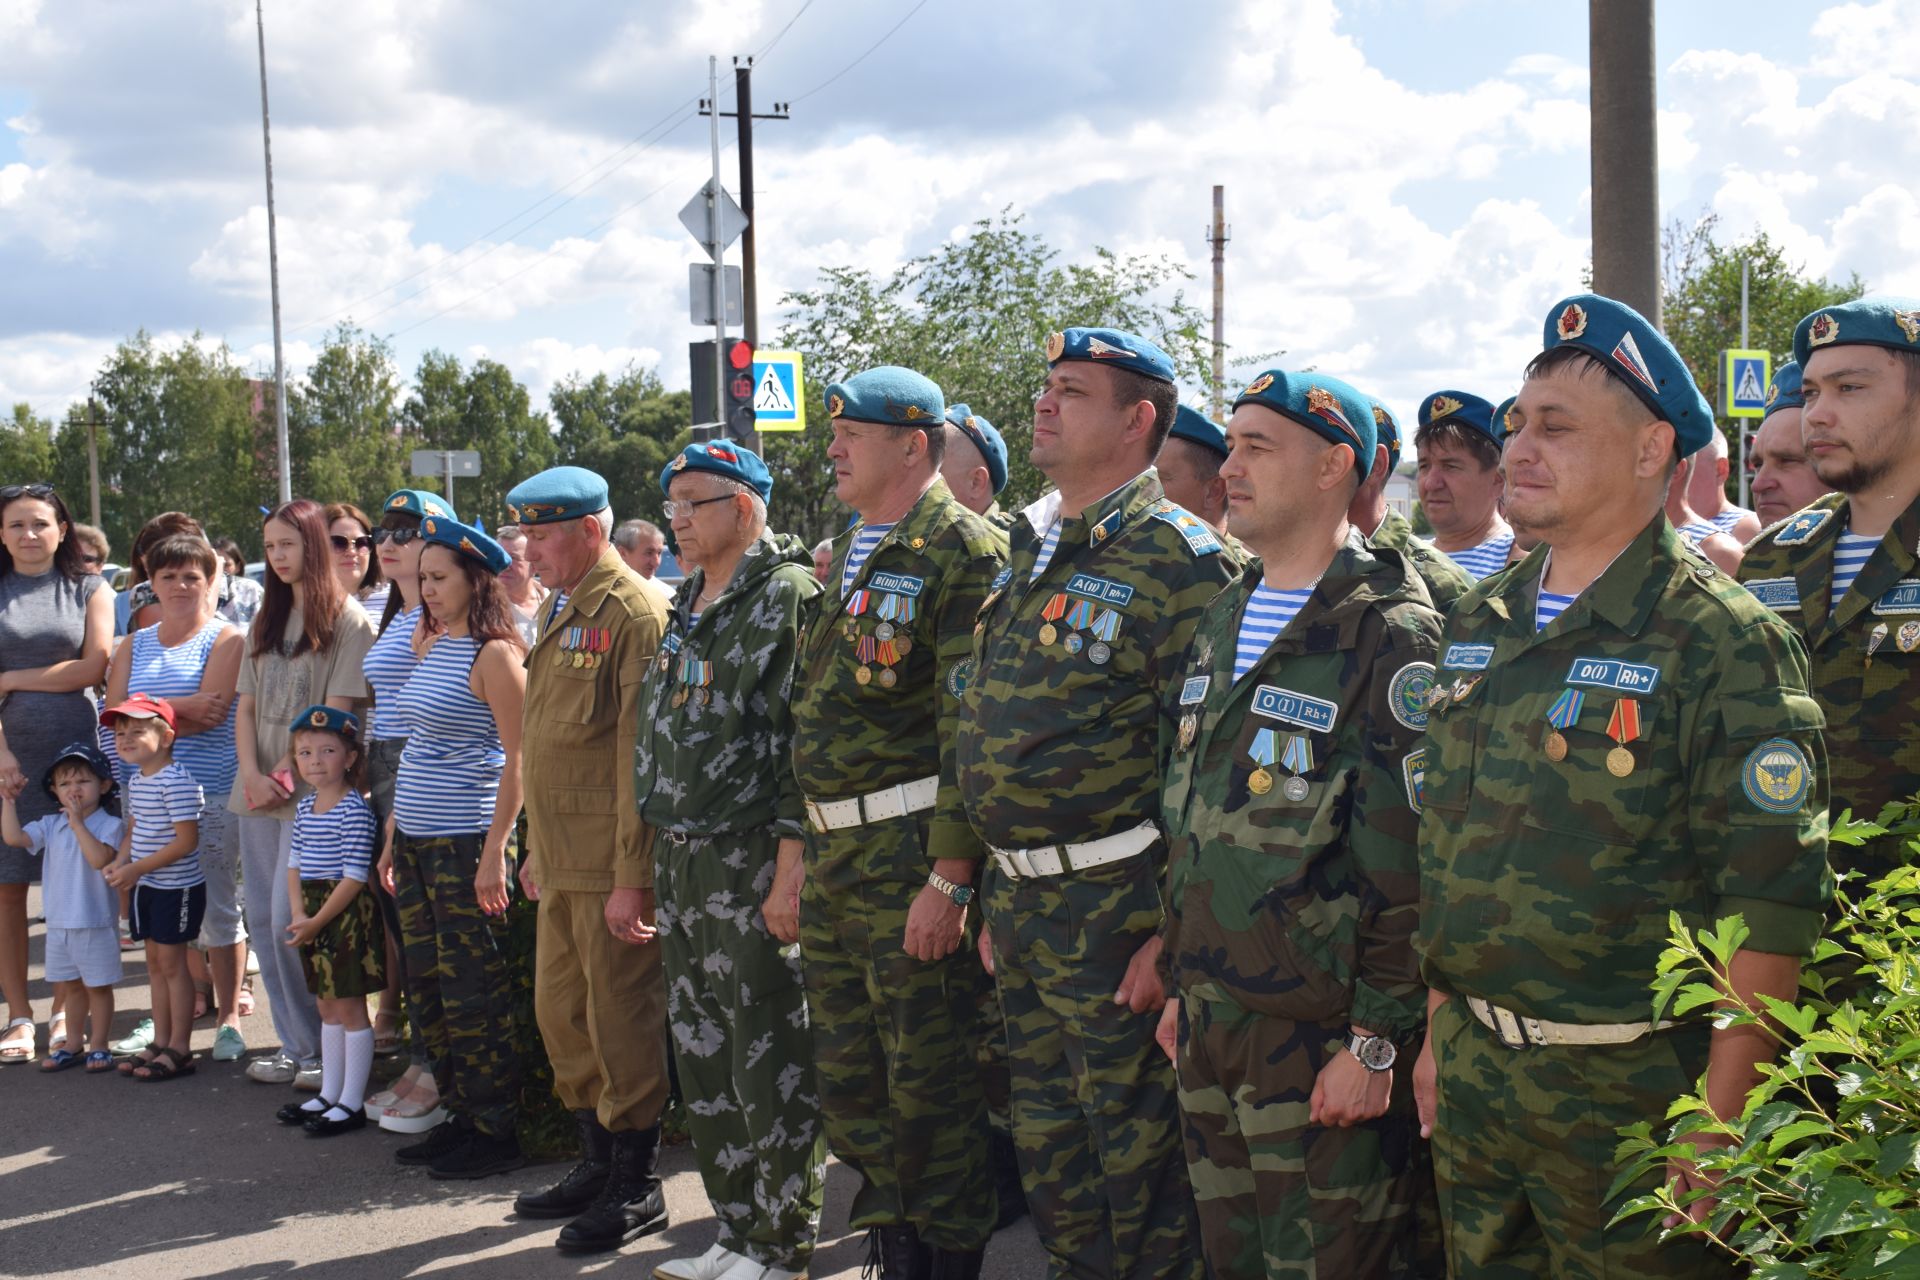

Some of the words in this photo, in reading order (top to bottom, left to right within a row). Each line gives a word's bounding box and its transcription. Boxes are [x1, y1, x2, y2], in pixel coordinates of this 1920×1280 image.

[902, 580, 919, 591] Rh+
[1073, 579, 1101, 593] A(II)
[1108, 589, 1127, 599] Rh+
[1892, 587, 1918, 603] A(II)
[1619, 669, 1649, 685] Rh+
[1303, 706, 1329, 720] Rh+
